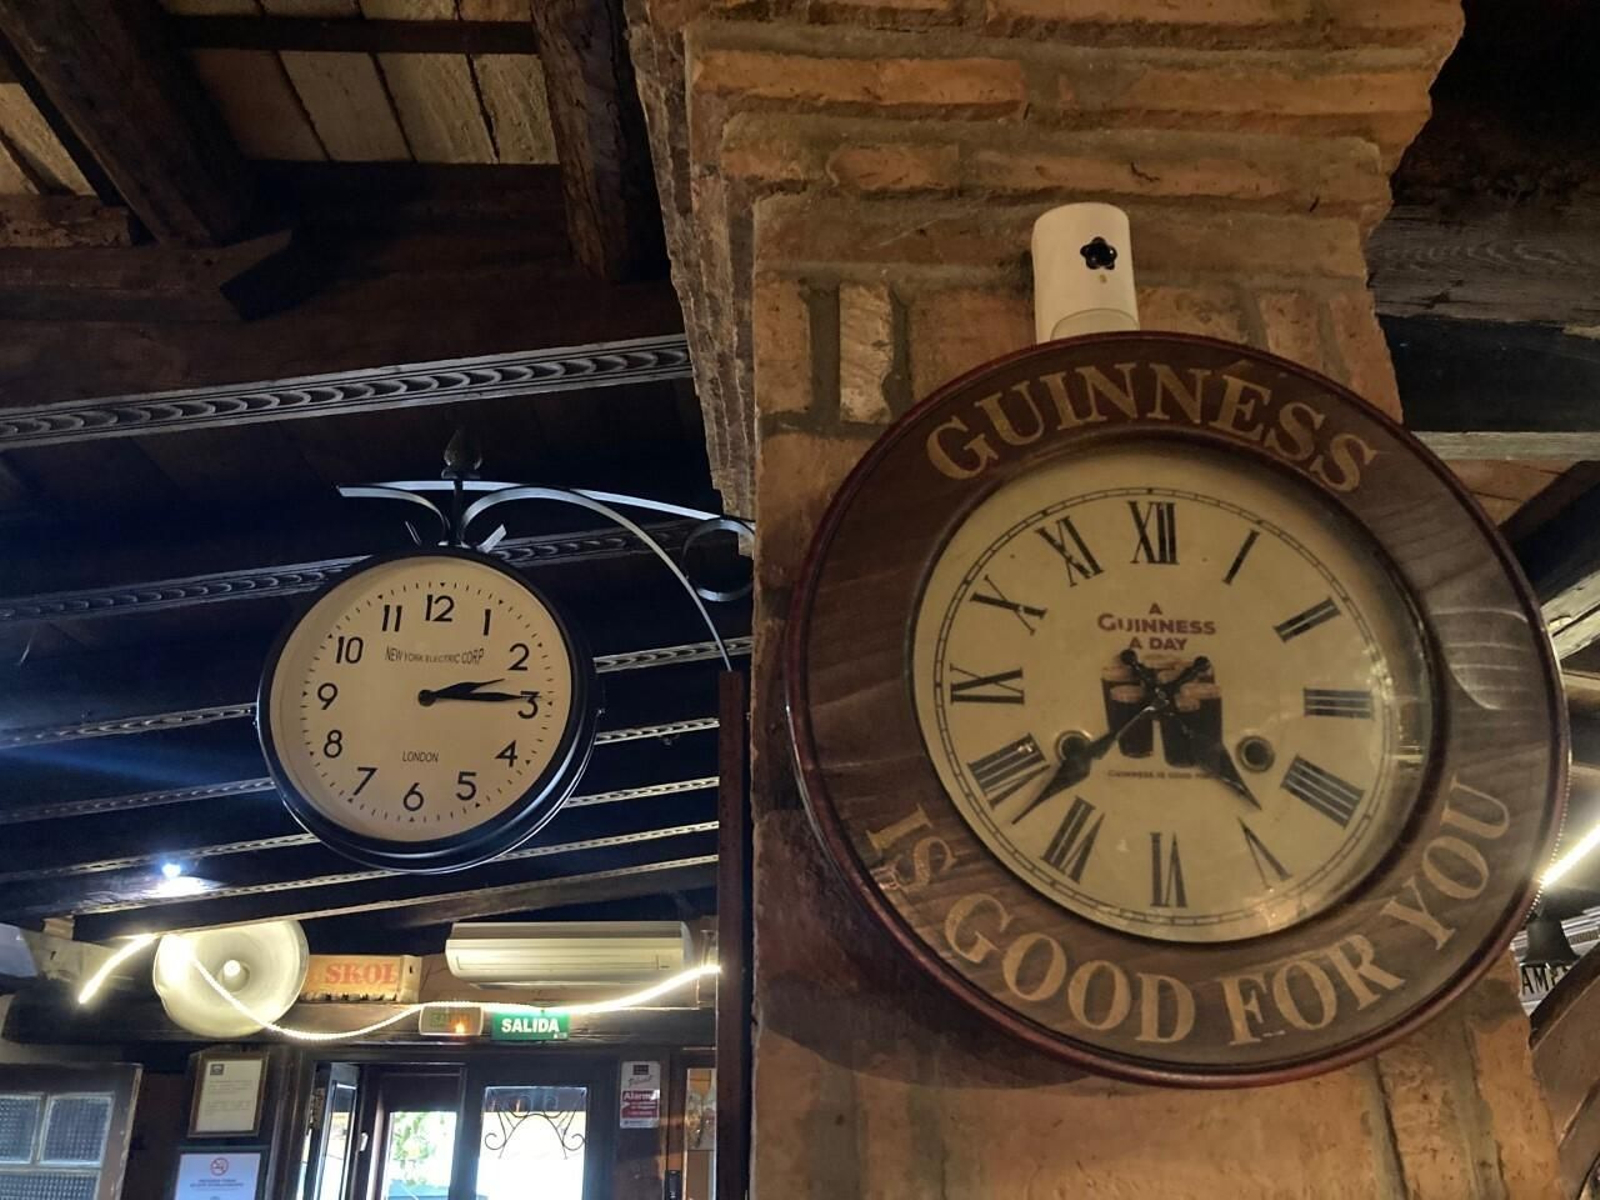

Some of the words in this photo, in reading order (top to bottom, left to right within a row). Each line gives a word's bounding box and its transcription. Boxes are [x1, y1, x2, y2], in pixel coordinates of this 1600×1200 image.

[1128, 501, 1179, 565] XII
[1035, 516, 1104, 587] XI
[1223, 529, 1260, 585] I
[381, 604, 402, 632] 11
[425, 594, 455, 622] 12
[970, 575, 1047, 636] X
[1149, 602, 1163, 615] A
[1273, 596, 1341, 643] II
[482, 608, 492, 636] 1
[1098, 613, 1216, 635] GUINNESS
[335, 636, 364, 664] 10
[508, 643, 530, 671] 2
[1129, 637, 1143, 650] A
[1149, 637, 1188, 651] DAY
[317, 682, 338, 710] 9
[950, 663, 1025, 705] IX
[517, 690, 540, 719] 3
[1303, 688, 1375, 720] III
[323, 729, 343, 758] 8
[402, 751, 439, 763] LONDON
[495, 740, 518, 767] 4
[353, 767, 378, 796] 7
[456, 771, 477, 800] 5
[966, 732, 1050, 812] VIII
[403, 783, 424, 811] 6
[1041, 795, 1105, 885] VII
[1237, 817, 1293, 893] V
[1150, 832, 1187, 908] VI
[866, 803, 958, 895] IS
[944, 893, 1195, 1044] GOOD
[1220, 934, 1406, 1046] FOR
[1380, 773, 1511, 950] YOU
[326, 963, 396, 984] SKOL
[502, 1018, 560, 1033] SALIDA
